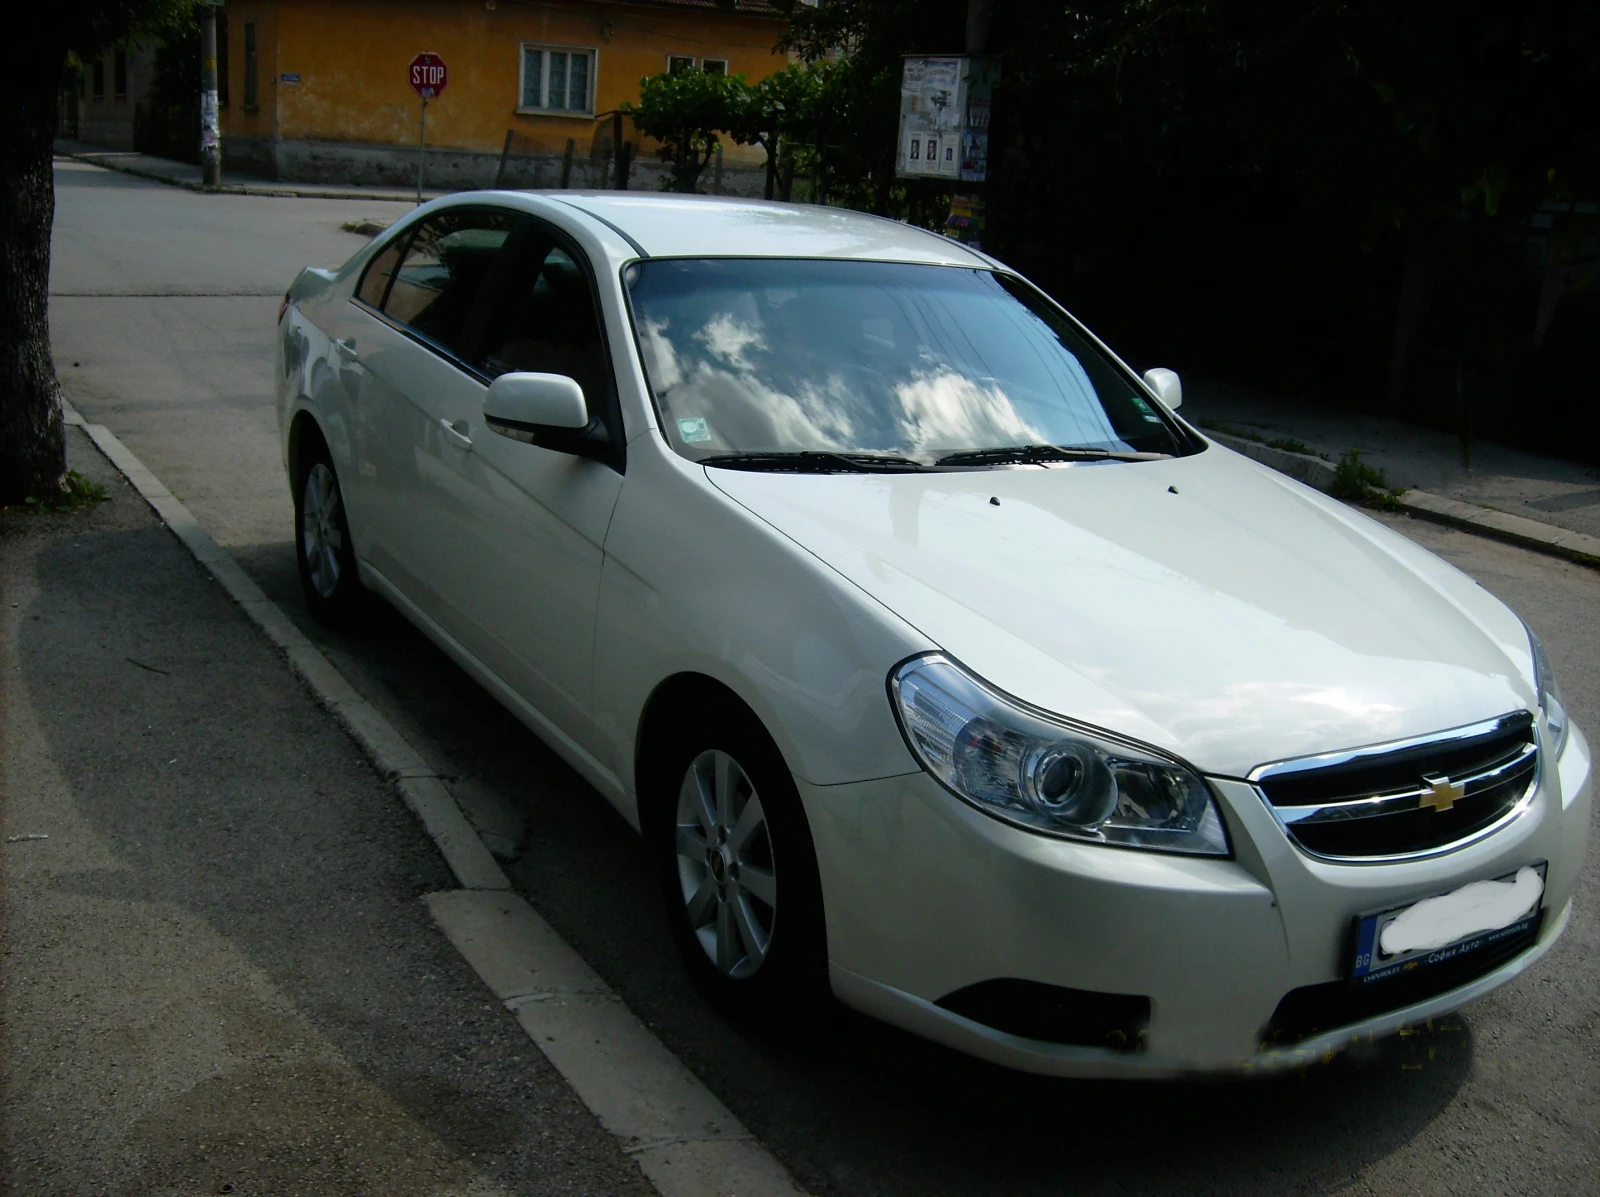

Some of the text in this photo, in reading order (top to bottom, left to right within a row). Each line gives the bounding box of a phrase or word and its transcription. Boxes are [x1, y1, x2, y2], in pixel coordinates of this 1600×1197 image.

[413, 65, 444, 84] STOP
[1355, 953, 1371, 969] BG
[1363, 966, 1400, 983] CHEVROLET
